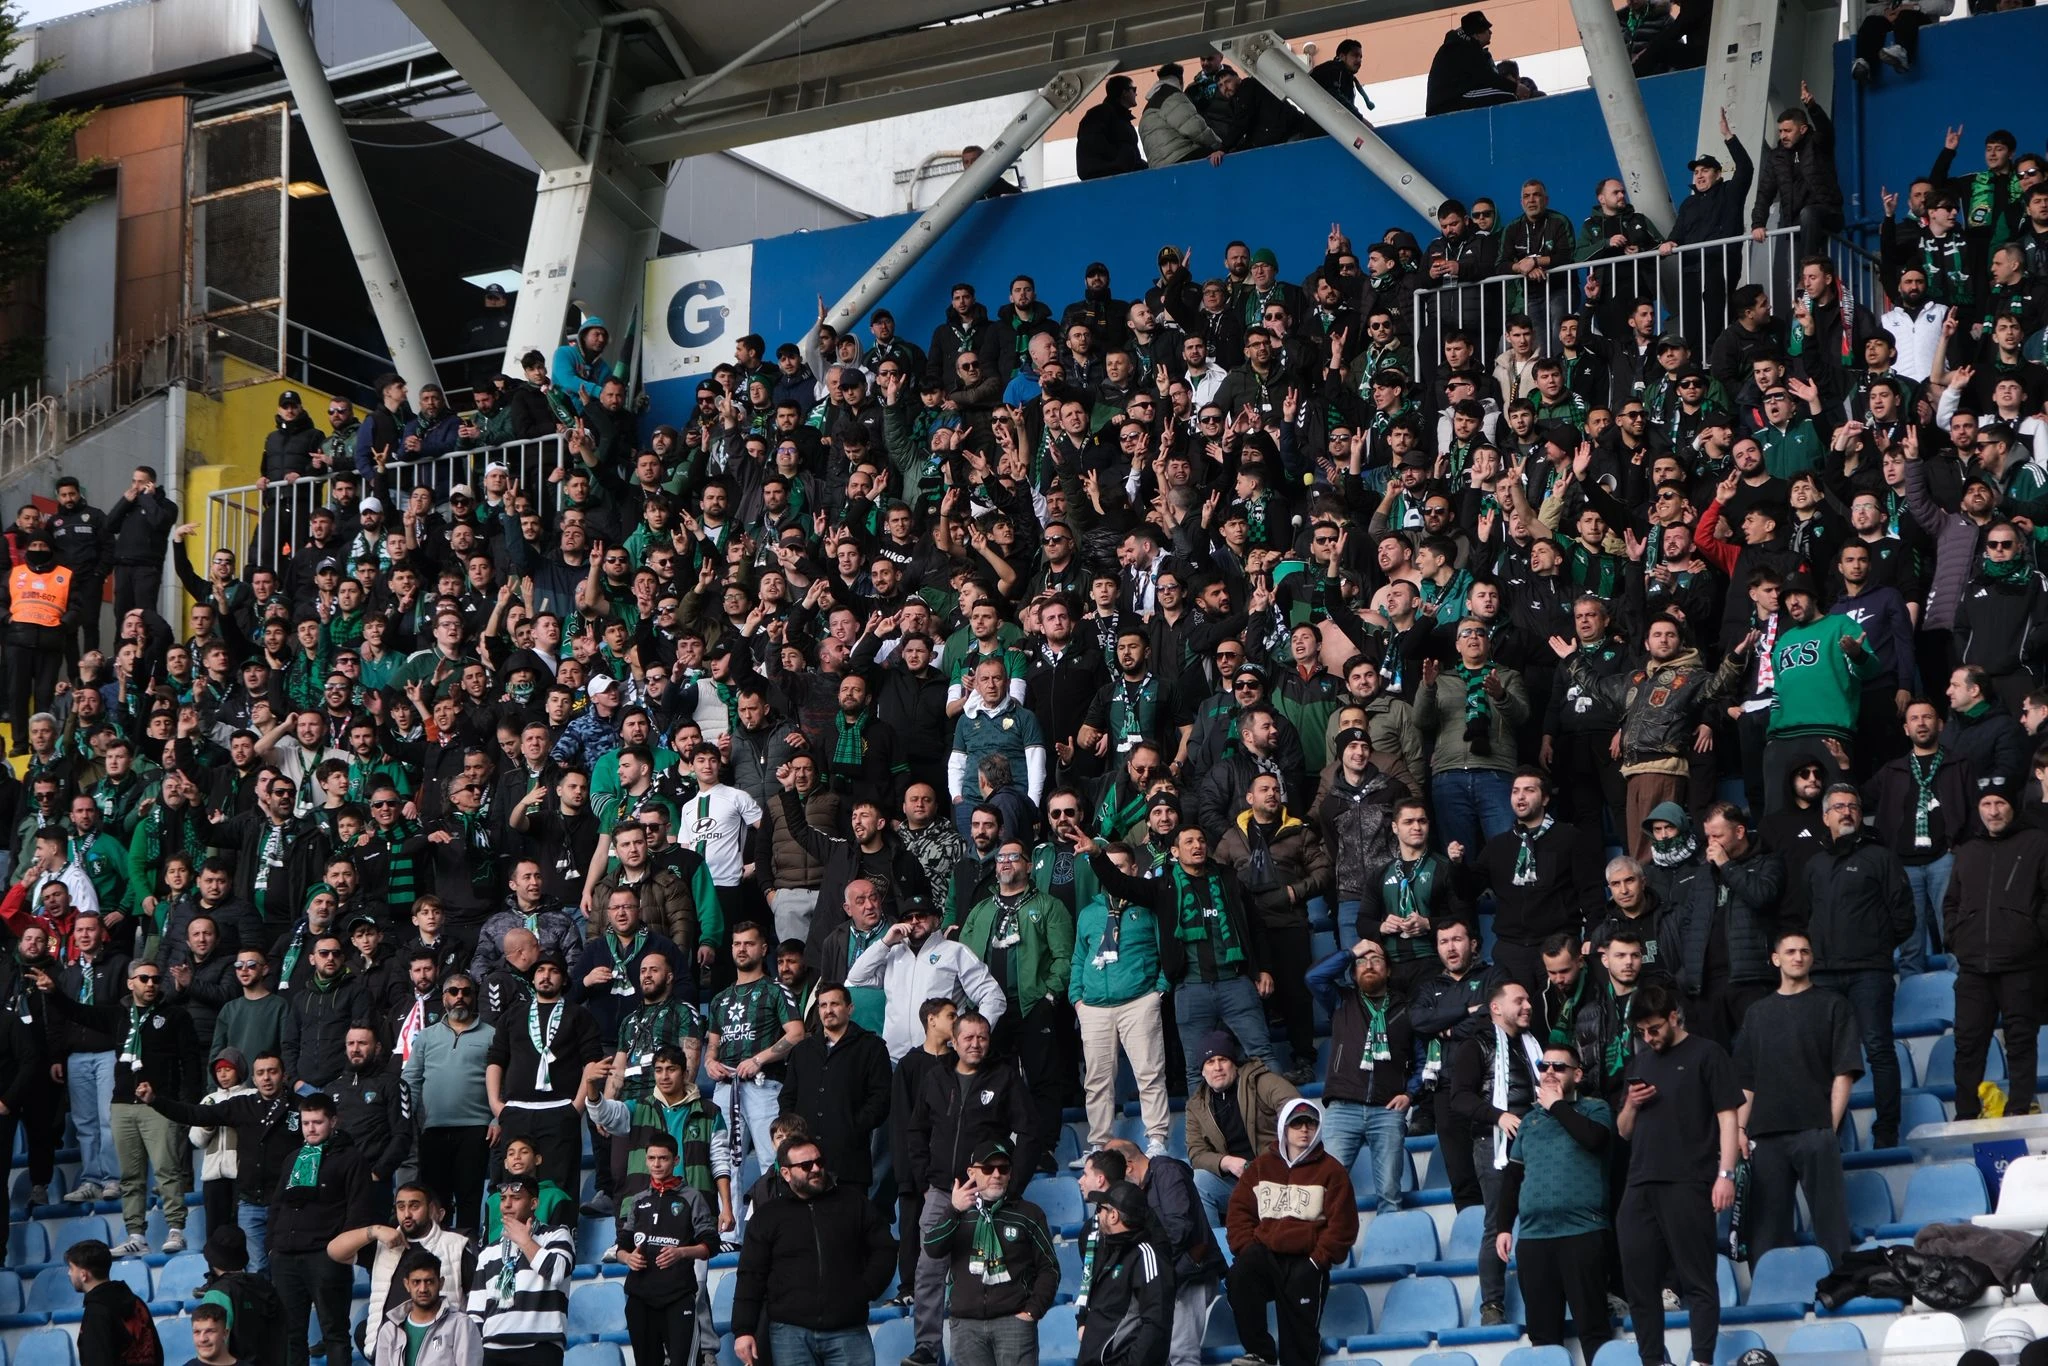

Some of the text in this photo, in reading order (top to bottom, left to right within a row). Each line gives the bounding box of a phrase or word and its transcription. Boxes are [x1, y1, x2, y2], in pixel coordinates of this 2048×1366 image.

[667, 280, 725, 348] G
[1259, 1186, 1311, 1214] GAP
[1004, 1226, 1017, 1237] 89
